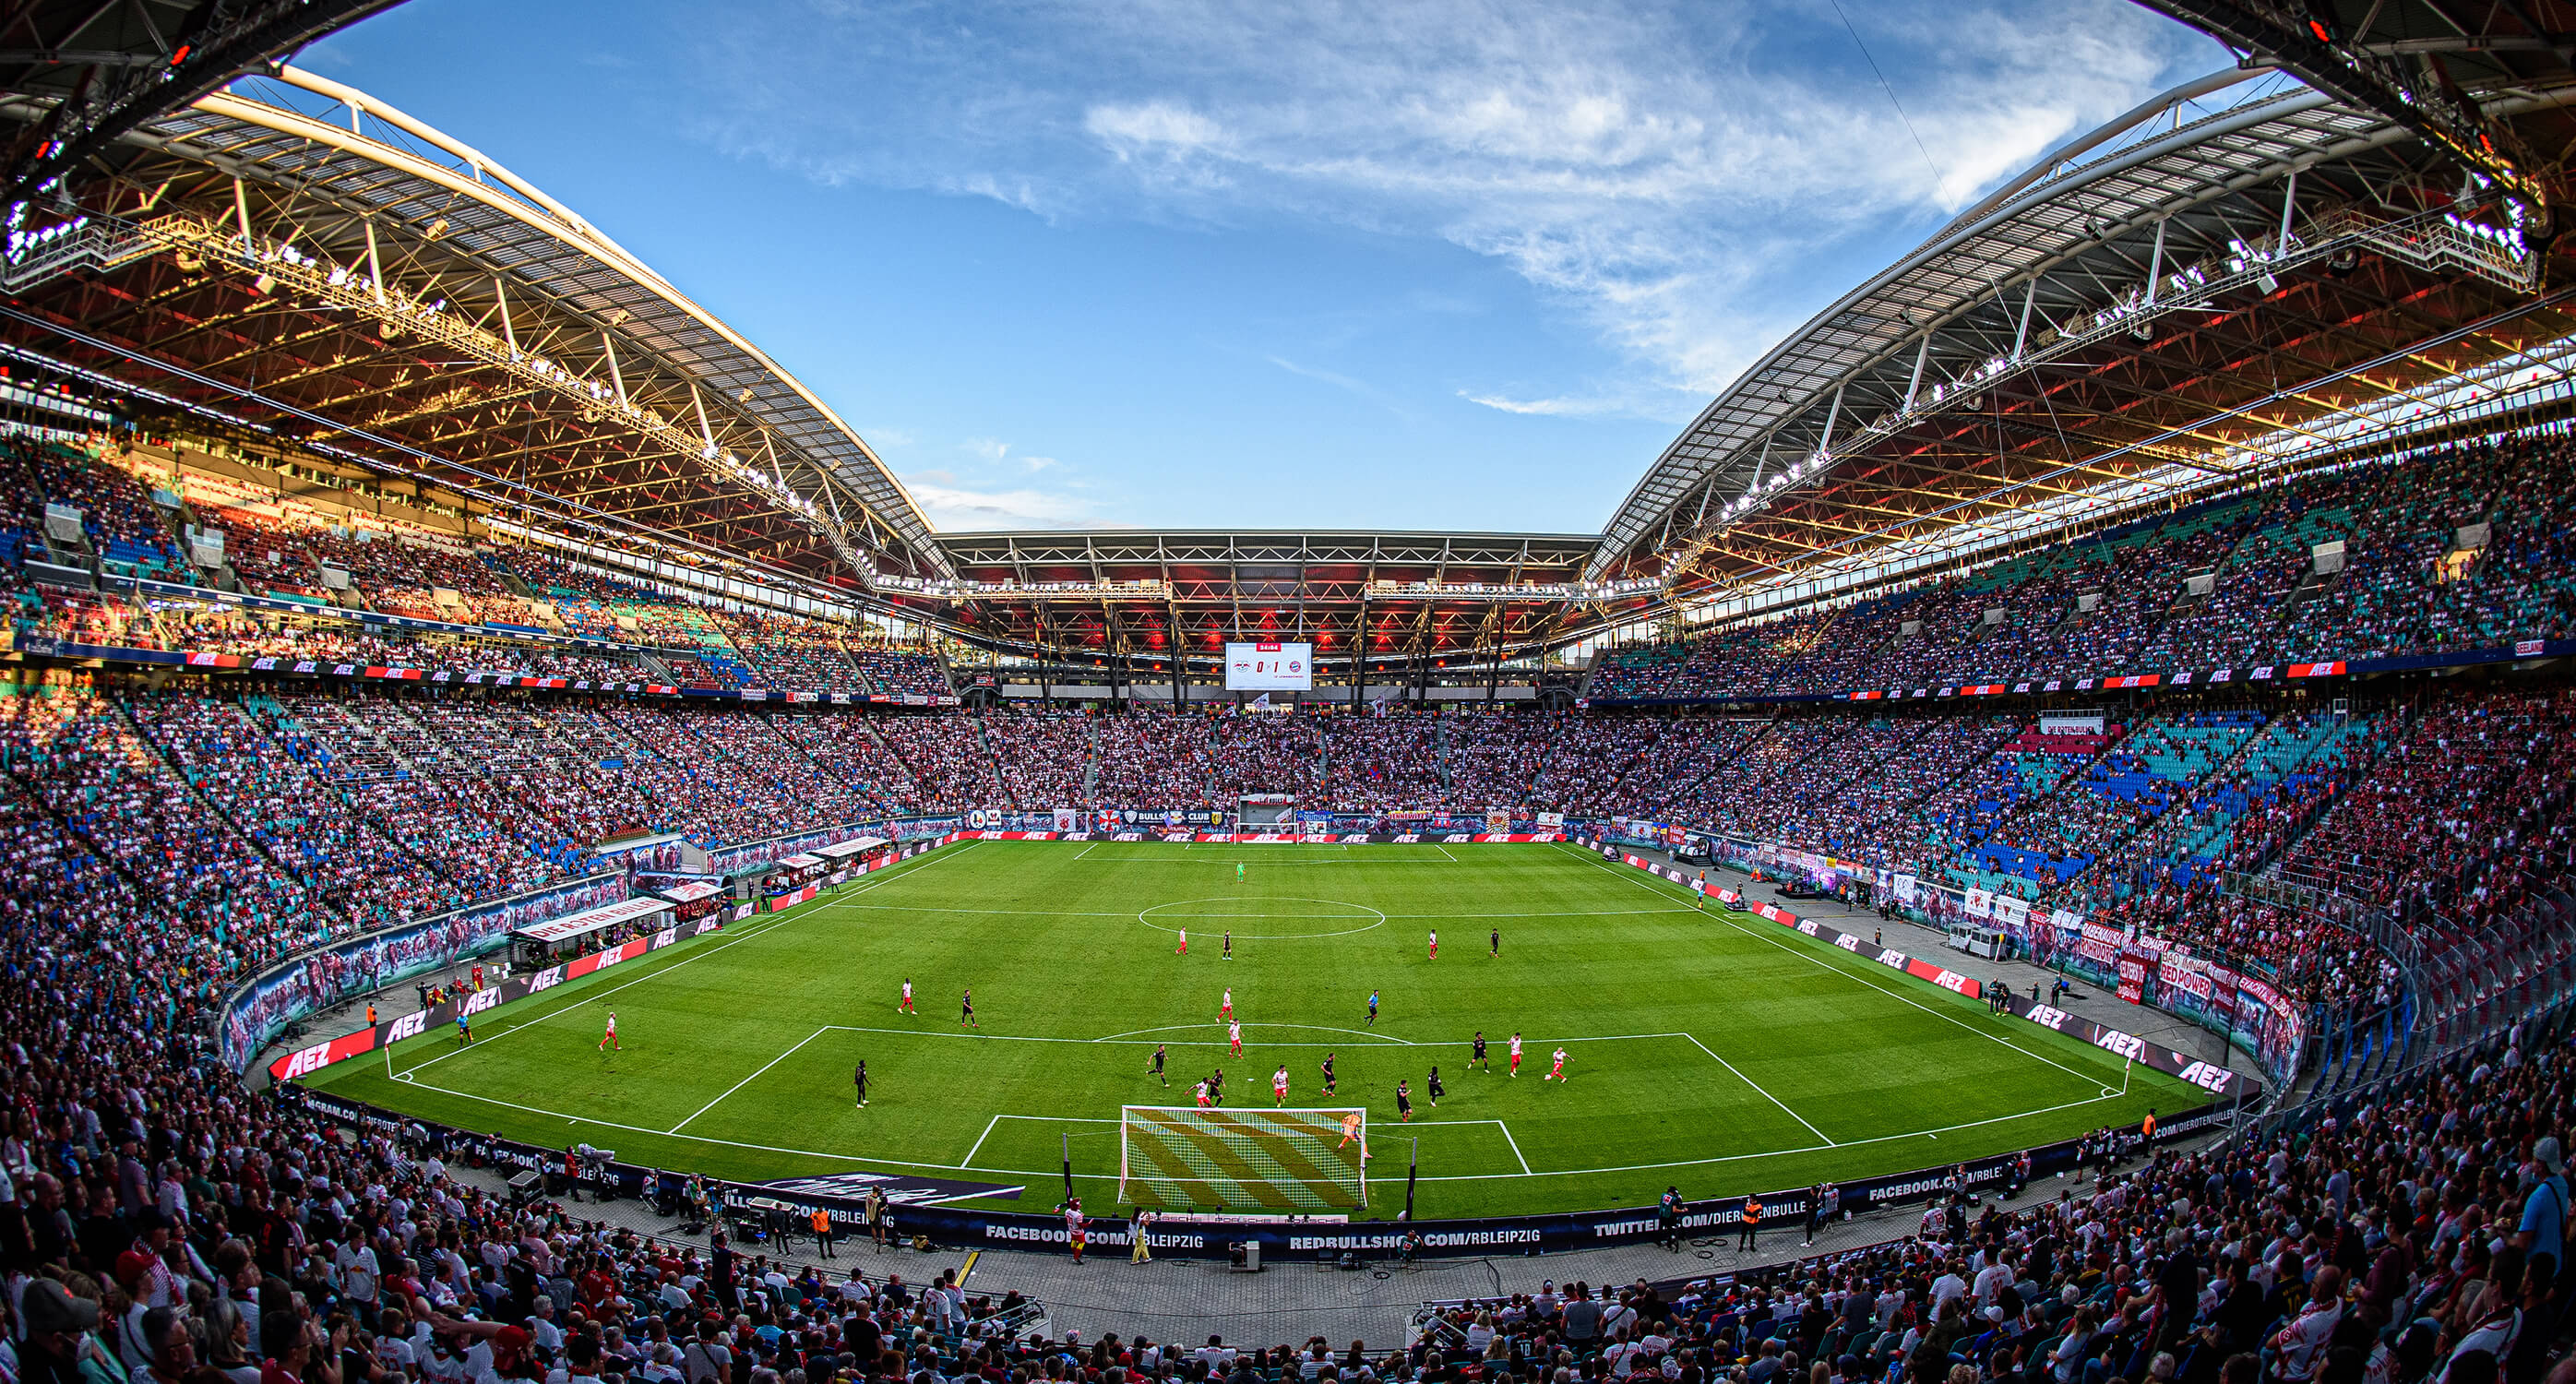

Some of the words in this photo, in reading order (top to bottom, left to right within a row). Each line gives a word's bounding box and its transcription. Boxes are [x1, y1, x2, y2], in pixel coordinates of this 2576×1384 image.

[192, 653, 217, 665] AEZ
[251, 657, 276, 670] AEZ
[293, 661, 317, 673] AEZ
[333, 664, 356, 675] AEZ
[385, 668, 405, 678] AEZ
[1257, 662, 1264, 673] 0
[1273, 662, 1279, 673] 1
[2249, 666, 2274, 679] AEZ
[2308, 662, 2334, 676] AEZ
[432, 671, 451, 681] AEZ
[464, 673, 483, 684] AEZ
[495, 675, 513, 686] AEZ
[2121, 675, 2141, 687] AEZ
[2170, 672, 2192, 685] AEZ
[2209, 670, 2232, 683] AEZ
[536, 678, 553, 687] AEZ
[2013, 683, 2030, 693] AEZ
[2043, 681, 2061, 691] AEZ
[2075, 679, 2094, 690] AEZ
[1912, 689, 1926, 698] AEZ
[1938, 687, 1952, 697] AEZ
[1974, 685, 1990, 695] AEZ
[978, 831, 1005, 840] AEZ
[1022, 831, 1049, 841] AEZ
[1063, 832, 1090, 841] AEZ
[1114, 833, 1139, 841] AEZ
[1163, 833, 1190, 841] AEZ
[1205, 833, 1233, 841] AEZ
[1341, 834, 1370, 842] AEZ
[1392, 834, 1420, 842] AEZ
[1442, 834, 1471, 842] AEZ
[1484, 833, 1512, 842] AEZ
[787, 891, 803, 907] AEZ
[734, 902, 754, 921] AEZ
[1759, 905, 1779, 921] AEZ
[530, 926, 566, 937] DIE
[564, 913, 613, 930] ROTEN
[610, 899, 664, 916] BULLEN
[695, 914, 718, 936] AEZ
[1797, 918, 1819, 937] AEZ
[652, 928, 676, 950] AEZ
[1834, 933, 1860, 952] AEZ
[596, 945, 623, 970] AEZ
[1878, 949, 1906, 970] AEZ
[529, 966, 561, 994] AEZ
[1934, 970, 1966, 992] AEZ
[2161, 963, 2178, 986] RED
[2177, 969, 2211, 999] POWER
[464, 986, 497, 1016] AEZ
[2025, 1004, 2068, 1031] AEZ
[386, 1010, 427, 1044] AEZ
[2097, 1031, 2142, 1059] AEZ
[282, 1042, 330, 1080] AEZ
[2178, 1061, 2233, 1093] AEZ
